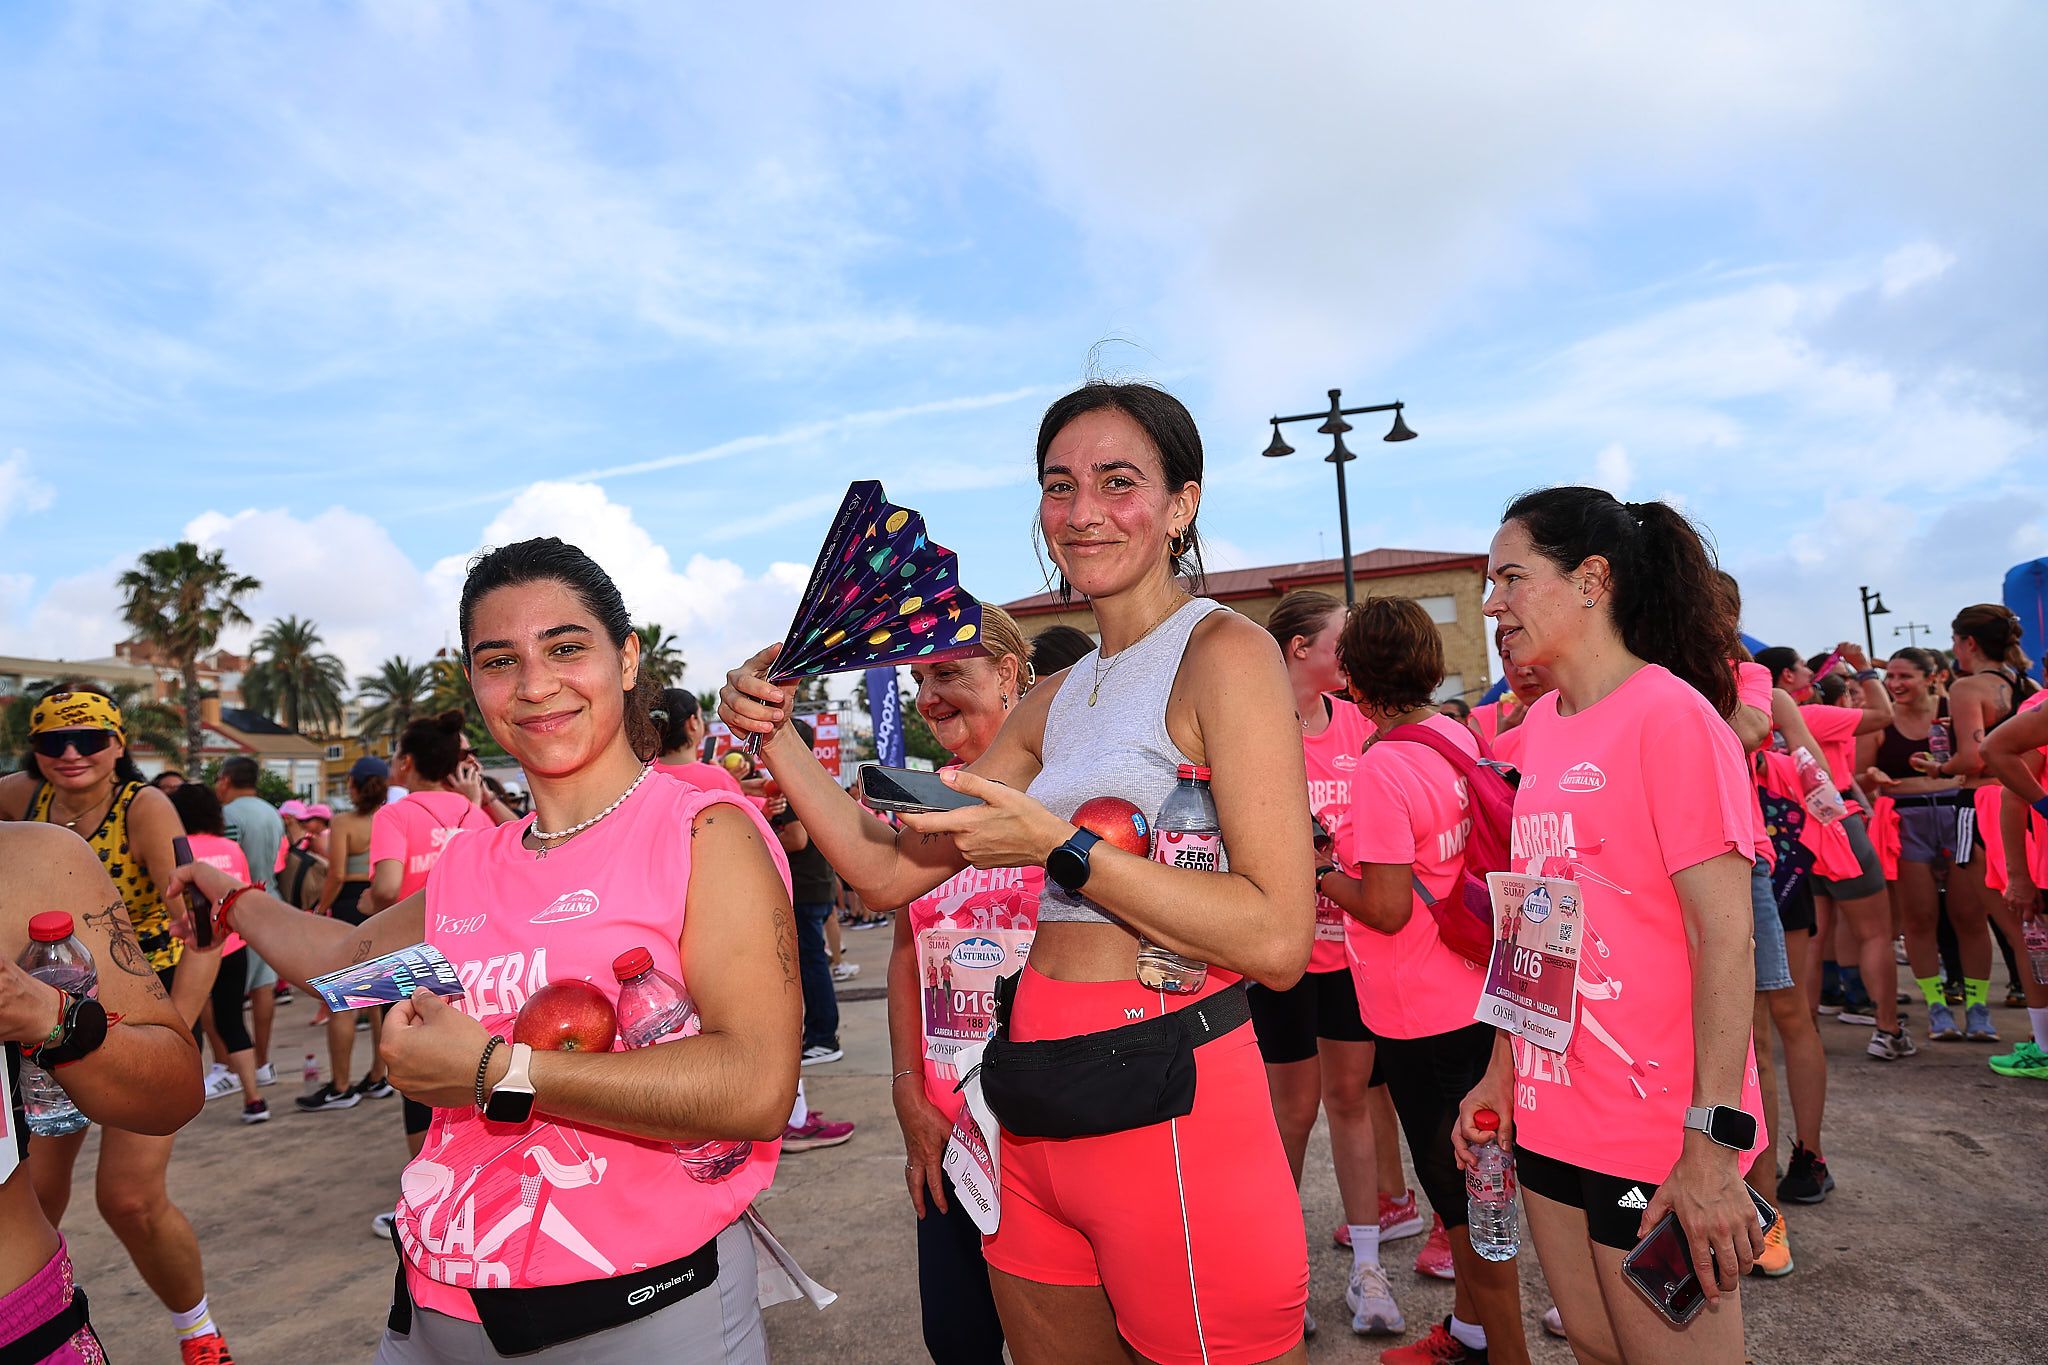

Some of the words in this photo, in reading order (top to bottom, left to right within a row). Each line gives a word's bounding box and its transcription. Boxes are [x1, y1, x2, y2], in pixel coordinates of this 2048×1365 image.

[833, 494, 861, 542] energy
[1511, 812, 1577, 859] ARRERA
[1175, 850, 1214, 862] ZERO
[436, 913, 487, 935] YSHO
[929, 941, 950, 950] SUMA
[955, 948, 1001, 961] ASTURIANA
[1514, 947, 1543, 978] 016
[954, 991, 996, 1014] 016
[1124, 1008, 1144, 1019] YM
[934, 1027, 953, 1037] CARRERA
[960, 1029, 969, 1038] LA
[967, 1018, 983, 1028] 188
[958, 1130, 965, 1141] DE
[971, 1142, 988, 1163] MUJER
[961, 1172, 991, 1213] Santander
[1618, 1199, 1647, 1209] adida
[656, 1269, 695, 1293] Kalenji
